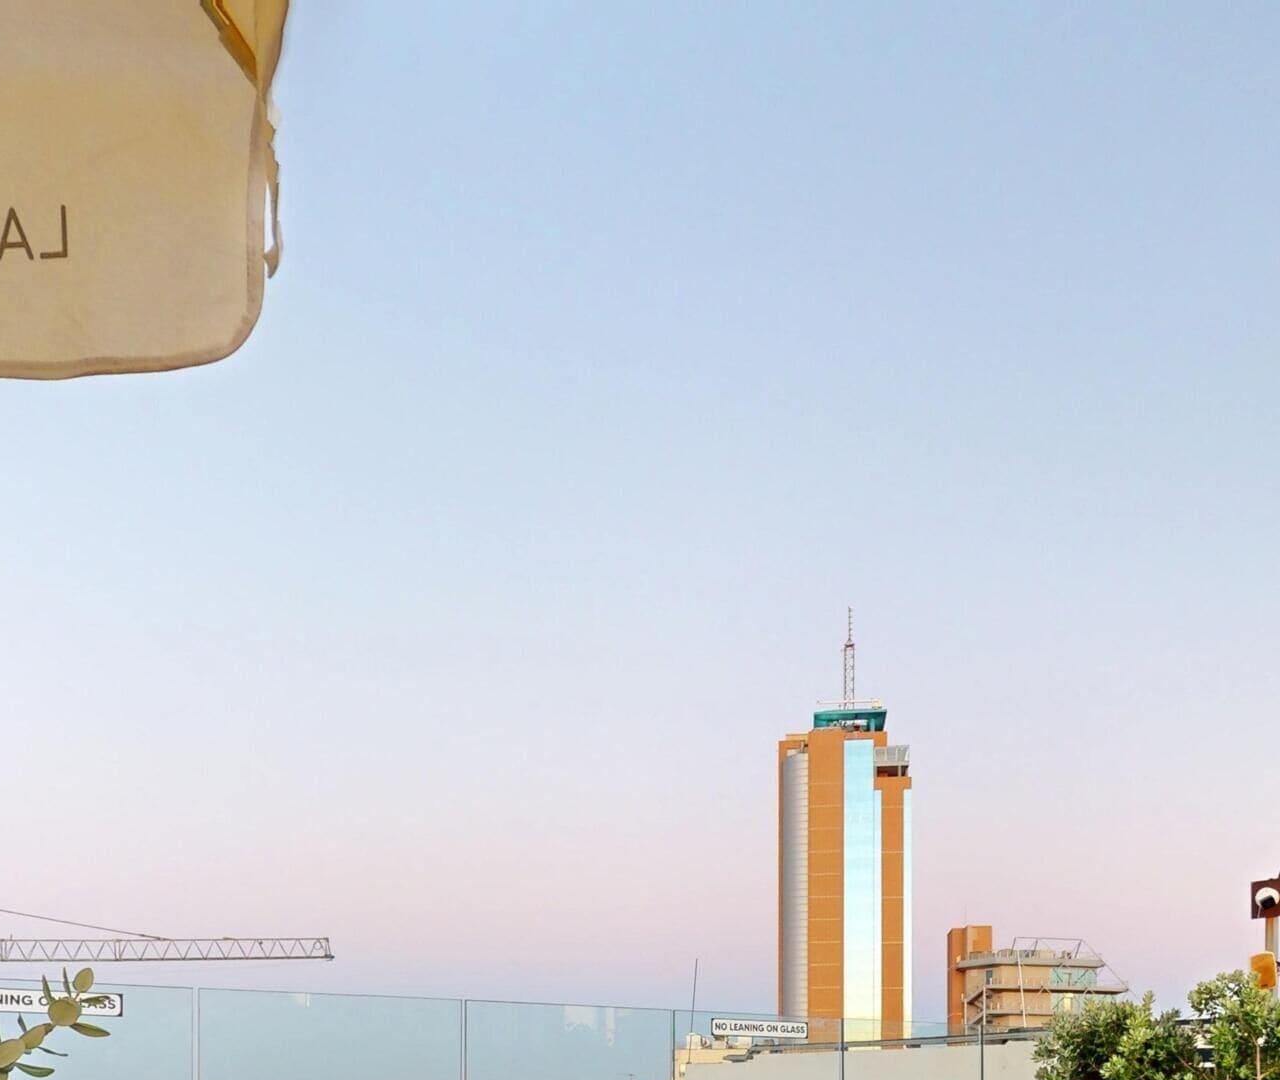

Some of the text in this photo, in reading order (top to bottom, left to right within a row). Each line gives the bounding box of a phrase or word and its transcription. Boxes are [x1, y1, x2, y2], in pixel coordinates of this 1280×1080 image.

[715, 1022, 805, 1033] NO LEANING ON GLASS
